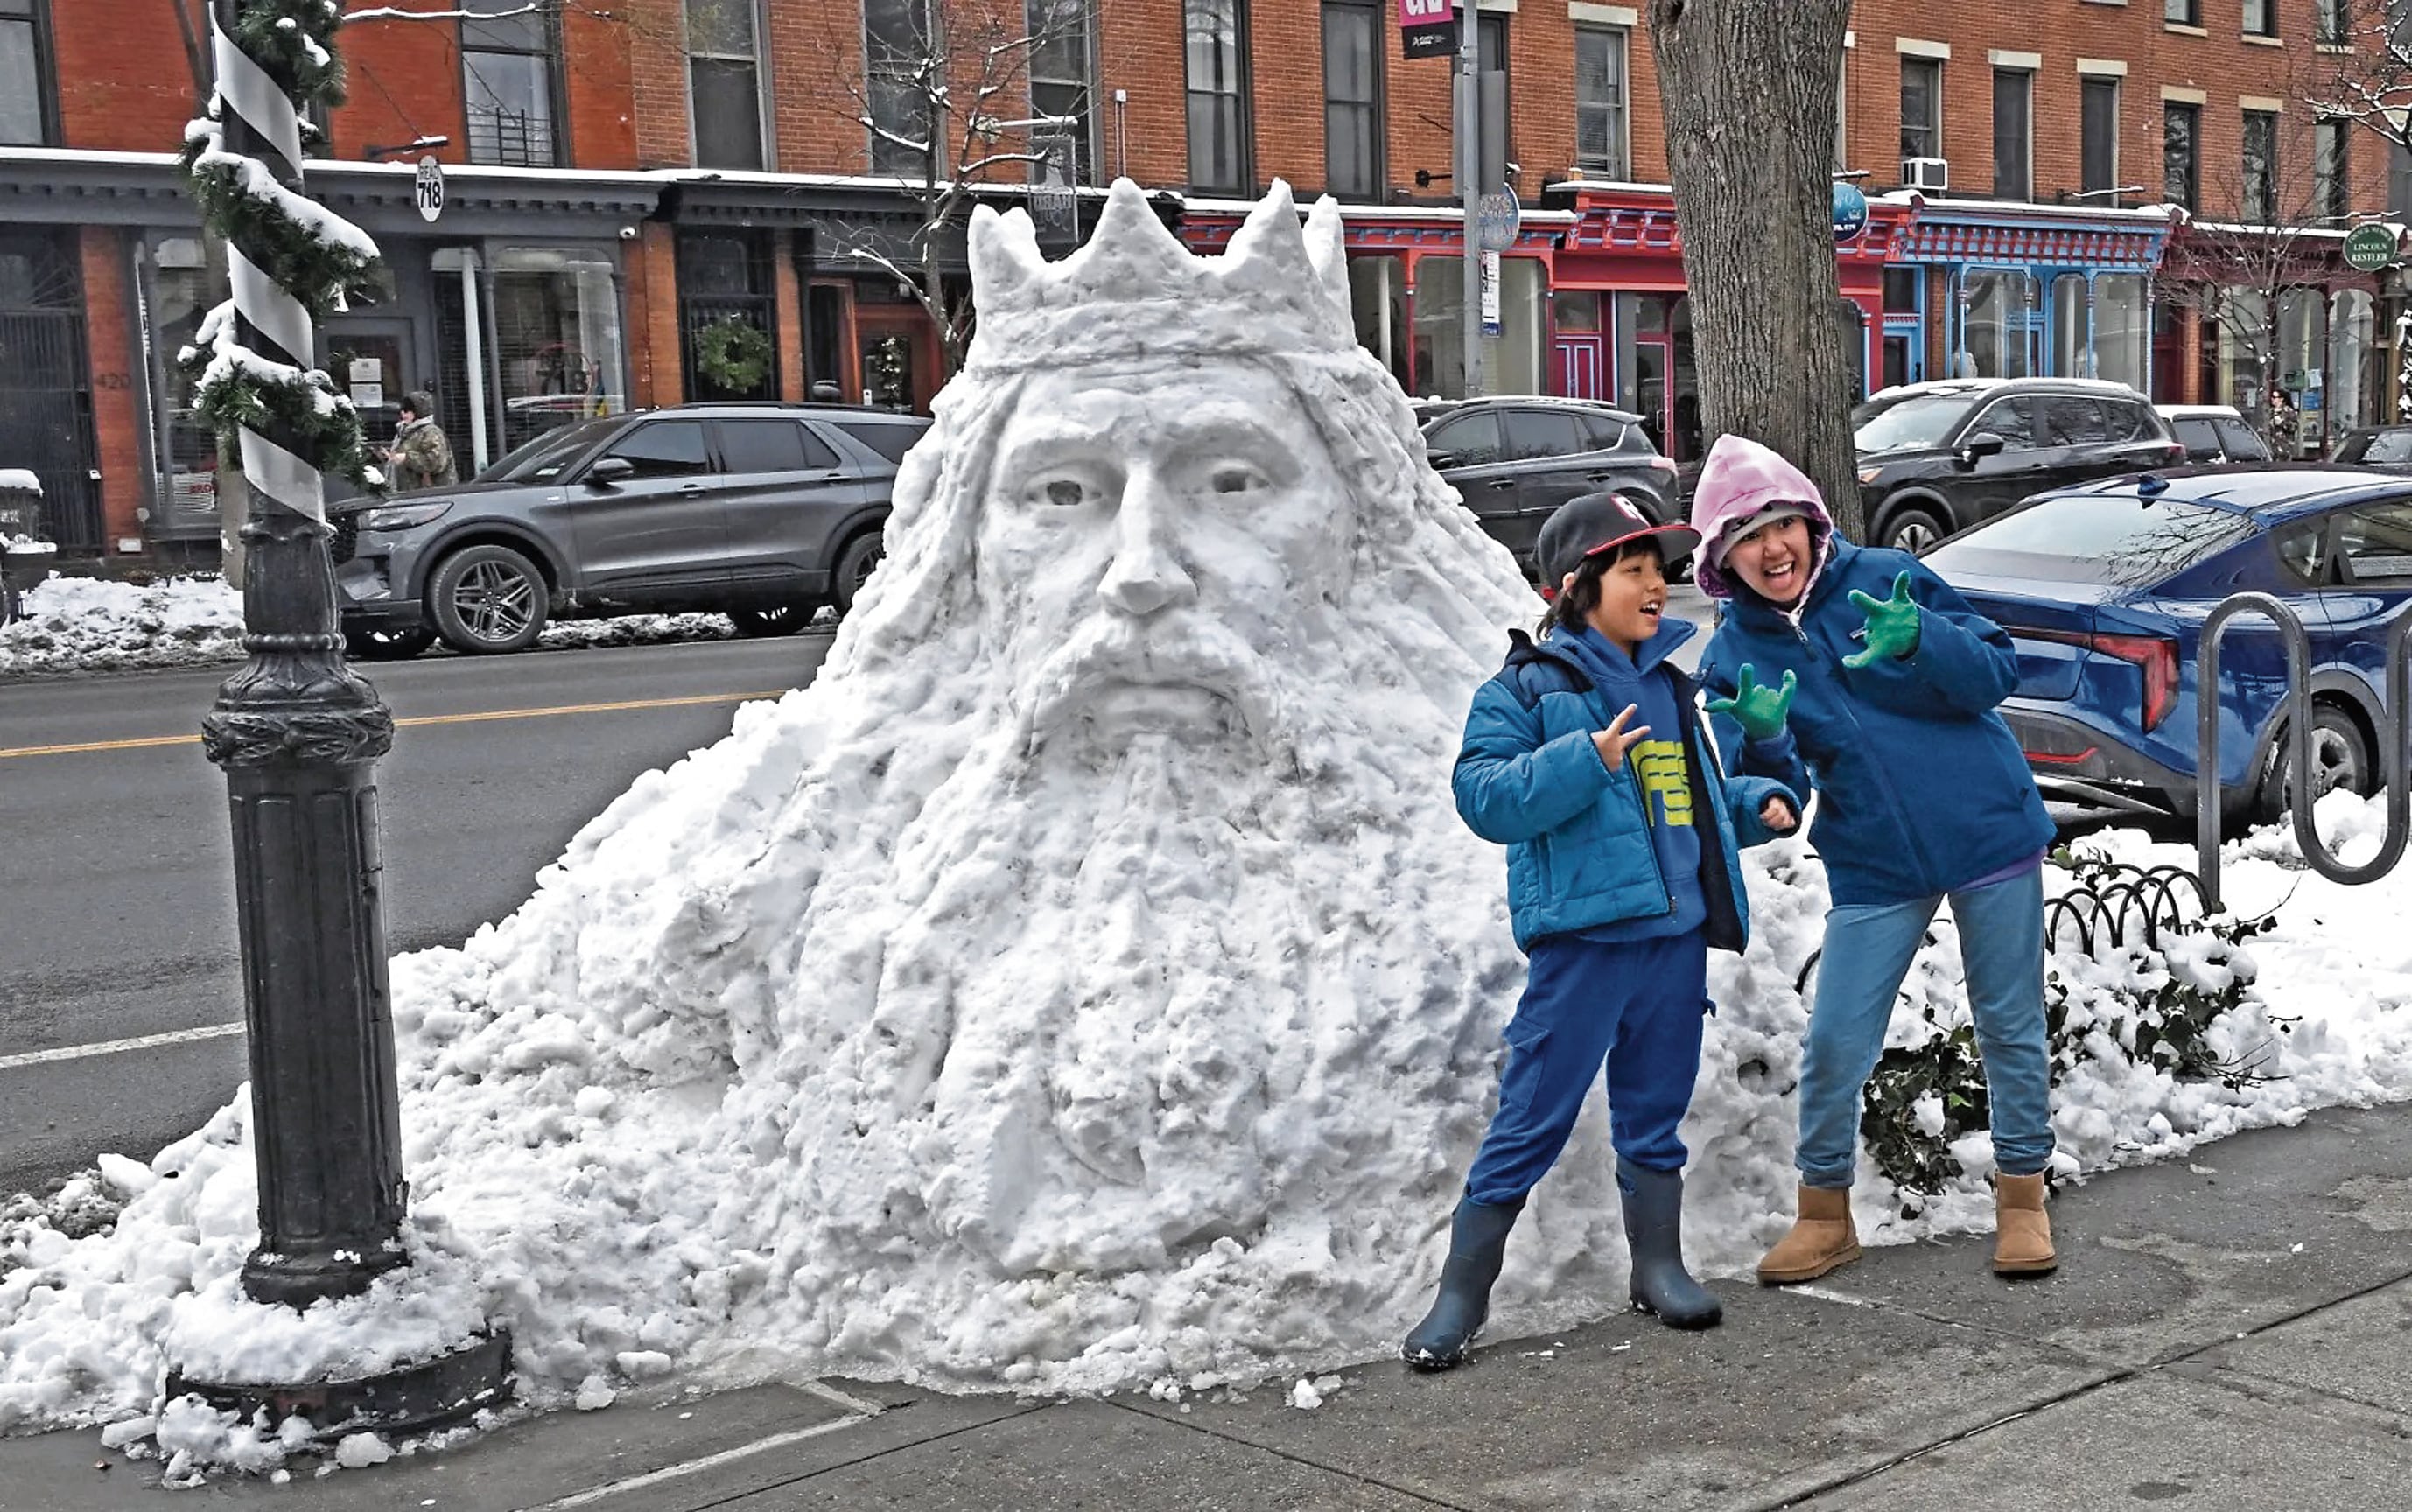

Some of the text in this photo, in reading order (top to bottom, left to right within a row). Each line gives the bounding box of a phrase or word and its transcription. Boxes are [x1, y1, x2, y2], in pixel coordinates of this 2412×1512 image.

[417, 181, 441, 208] 718
[2352, 253, 2387, 262] RESTLER
[96, 373, 132, 390] 420
